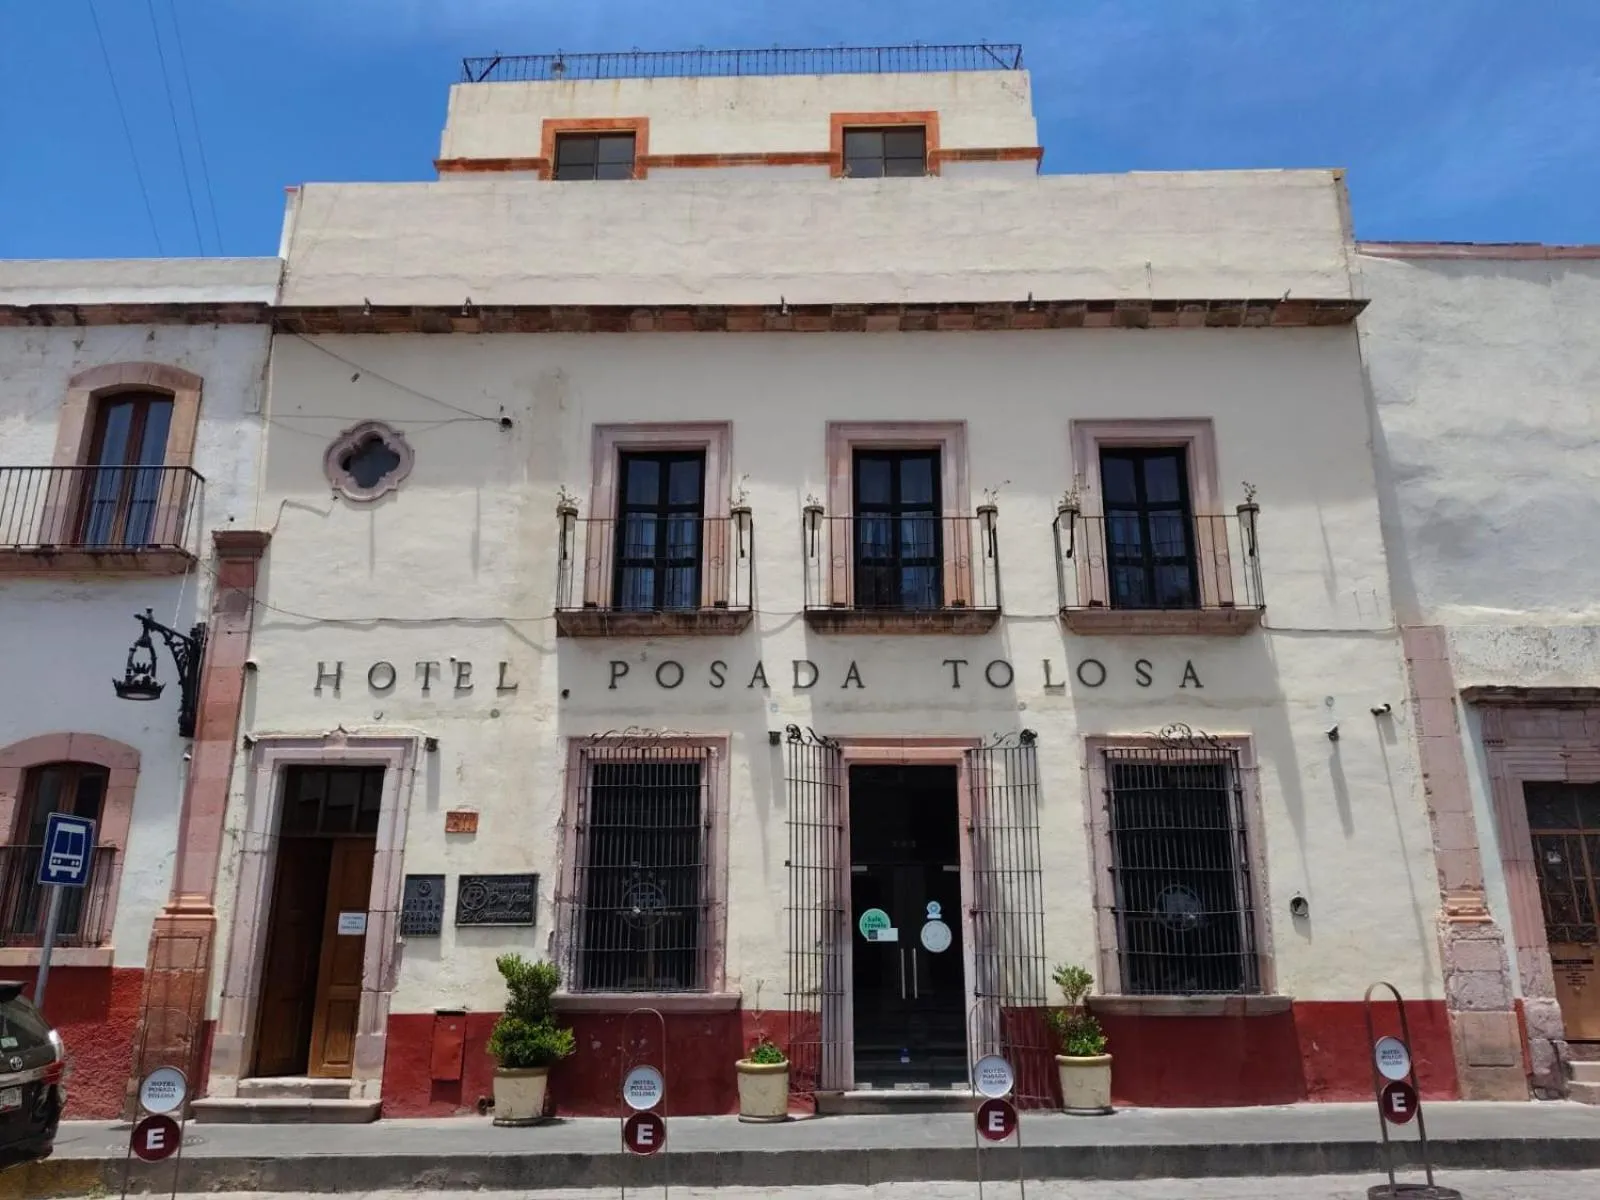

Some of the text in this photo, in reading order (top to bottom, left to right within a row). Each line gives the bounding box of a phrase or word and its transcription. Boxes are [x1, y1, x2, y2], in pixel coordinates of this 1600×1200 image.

[313, 658, 1204, 690] HOTEL POSADA TOLOSA
[1391, 1092, 1408, 1113] E
[988, 1110, 1005, 1132] E
[146, 1127, 166, 1150] E
[637, 1123, 654, 1145] E
